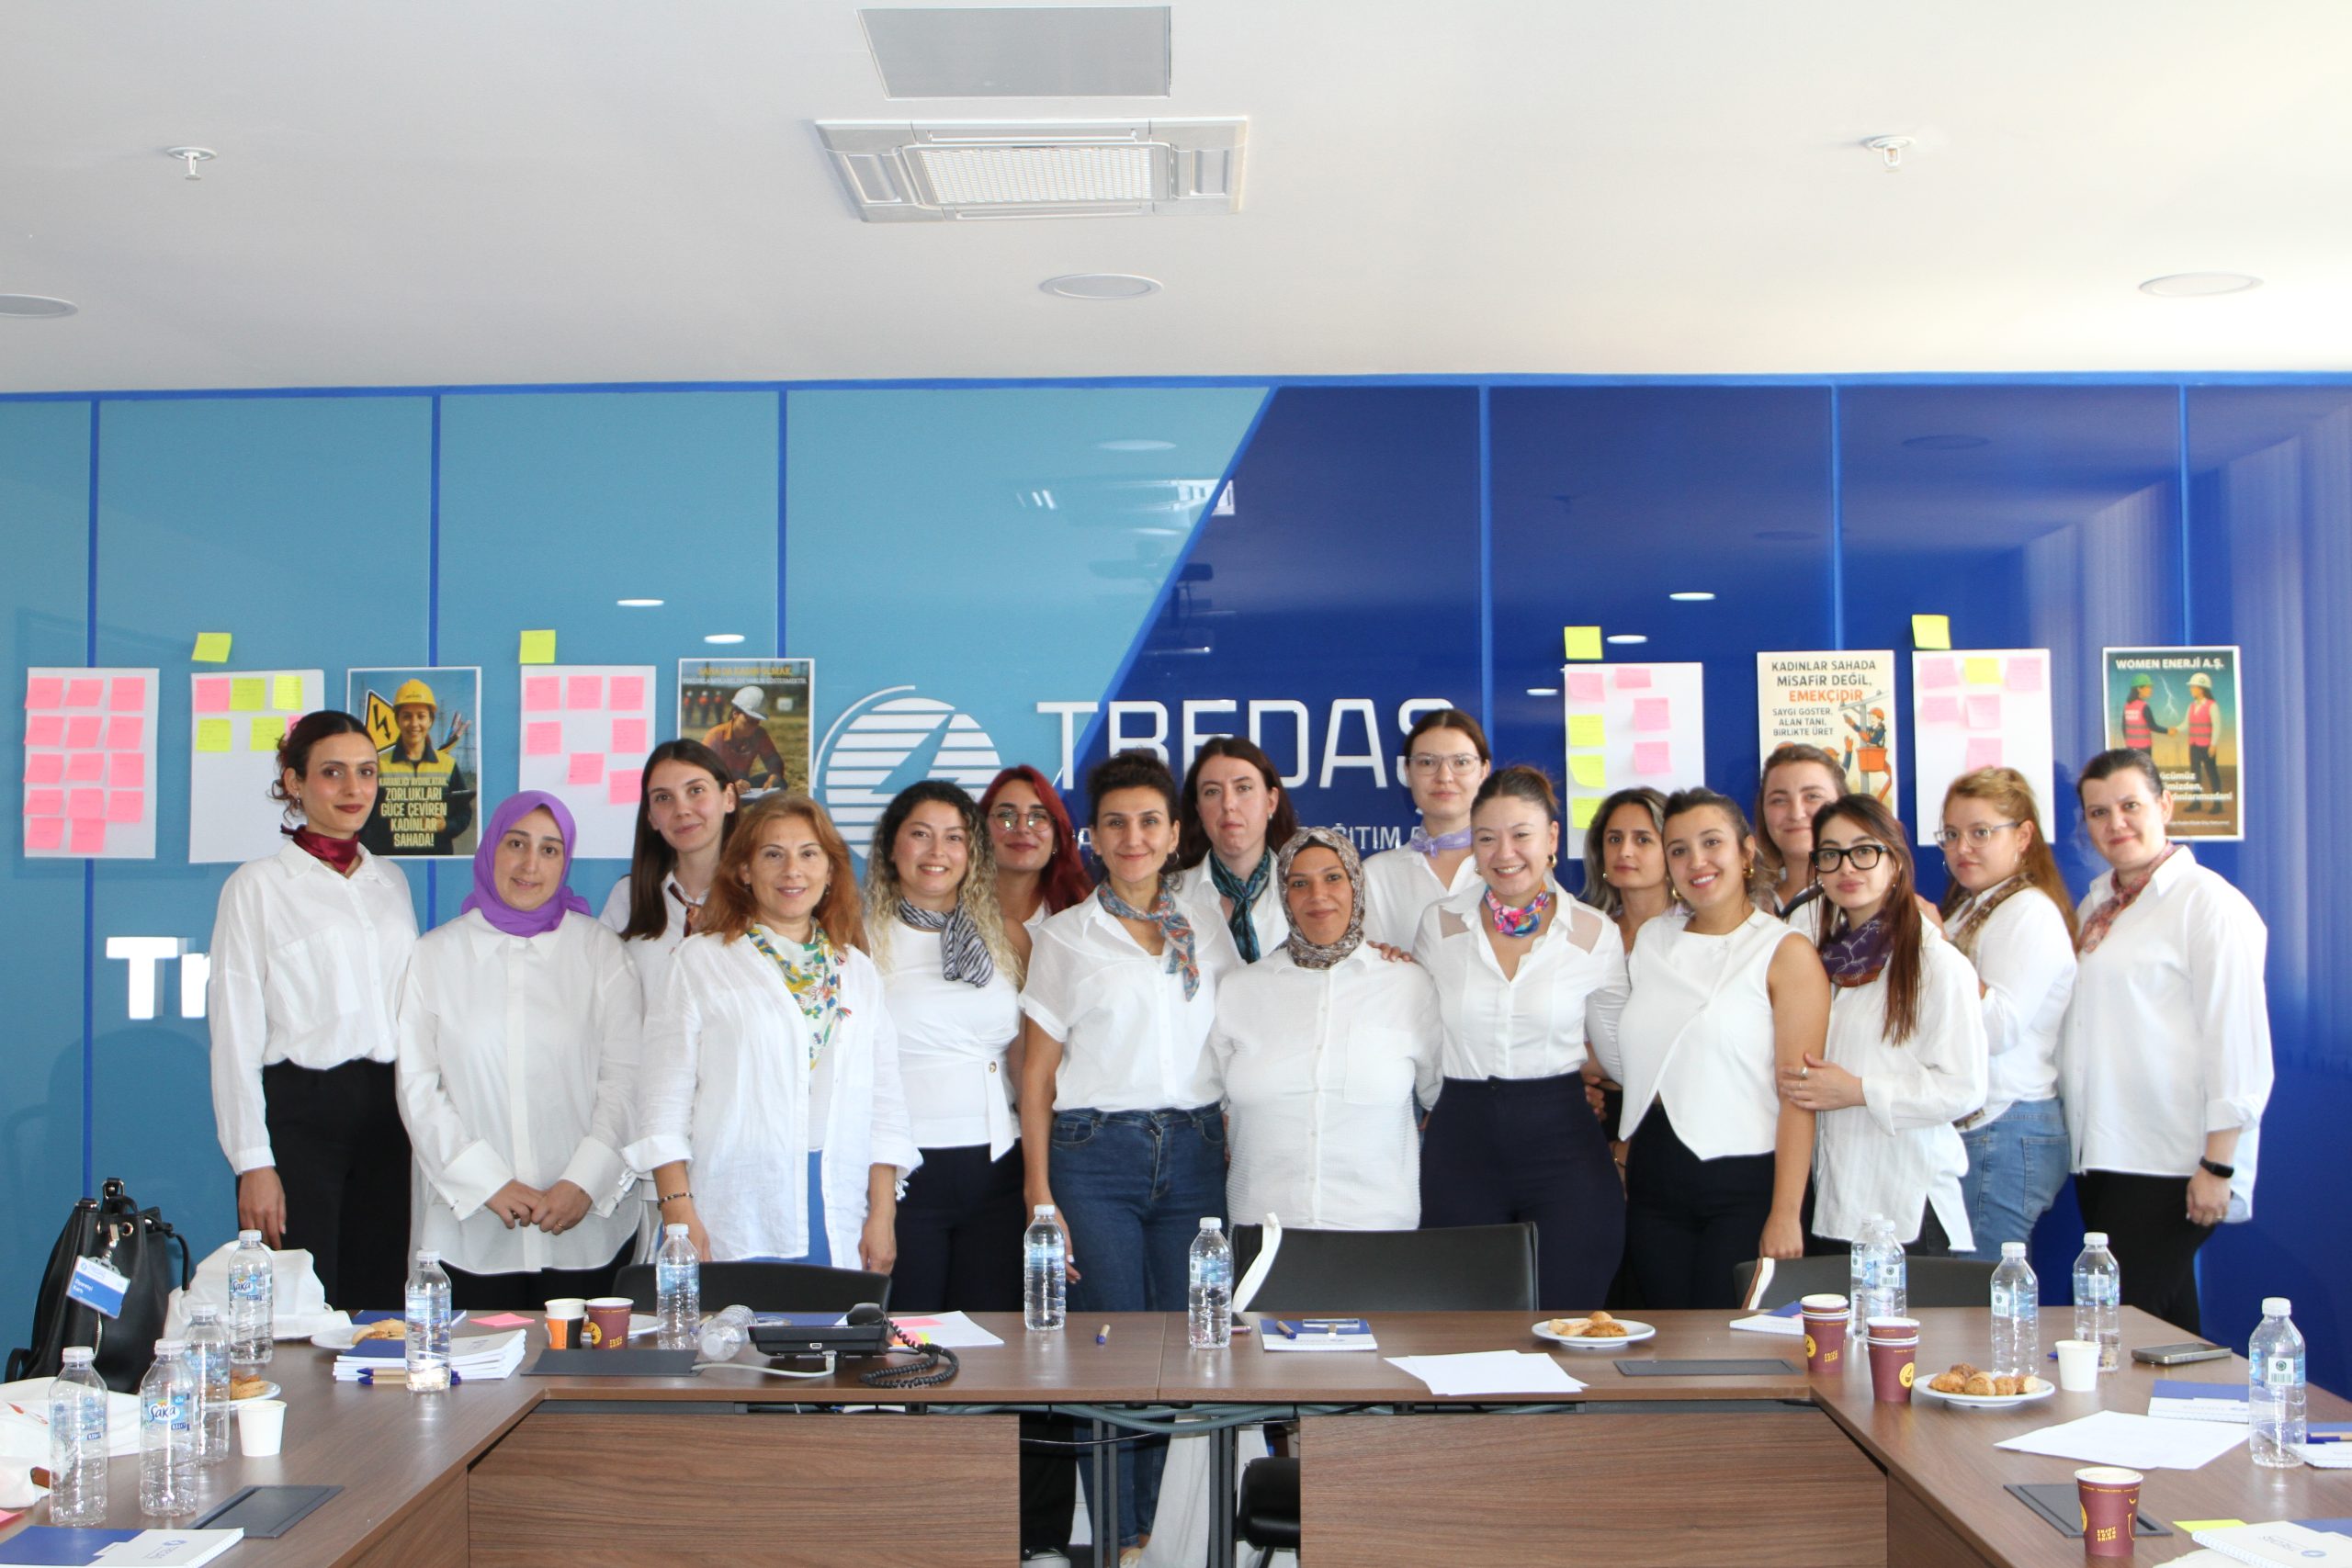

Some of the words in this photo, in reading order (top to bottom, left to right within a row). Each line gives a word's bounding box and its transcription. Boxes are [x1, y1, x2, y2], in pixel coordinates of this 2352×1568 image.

[1771, 661, 1827, 671] KADINLAR
[1831, 660, 1876, 671] SAHADA
[2116, 659, 2160, 670] WOMEN
[2162, 657, 2200, 669] ENERJİ
[2202, 658, 2224, 671] A.Ş.
[1777, 675, 1827, 686] MİSAFİR
[1832, 672, 1872, 686] DEĞİL,
[1789, 690, 1863, 703] EMEKÇİDİR
[1813, 725, 1833, 736] ÜRET
[2160, 772, 2196, 780] ücümüz
[2164, 782, 2202, 791] imizden,
[385, 787, 442, 801] ZORLUKLARI
[381, 801, 404, 816] GÜCE
[407, 801, 447, 818] ÇEVİREN
[393, 833, 434, 846] SAHADA!
[2097, 1526, 2116, 1534] ENJOY
